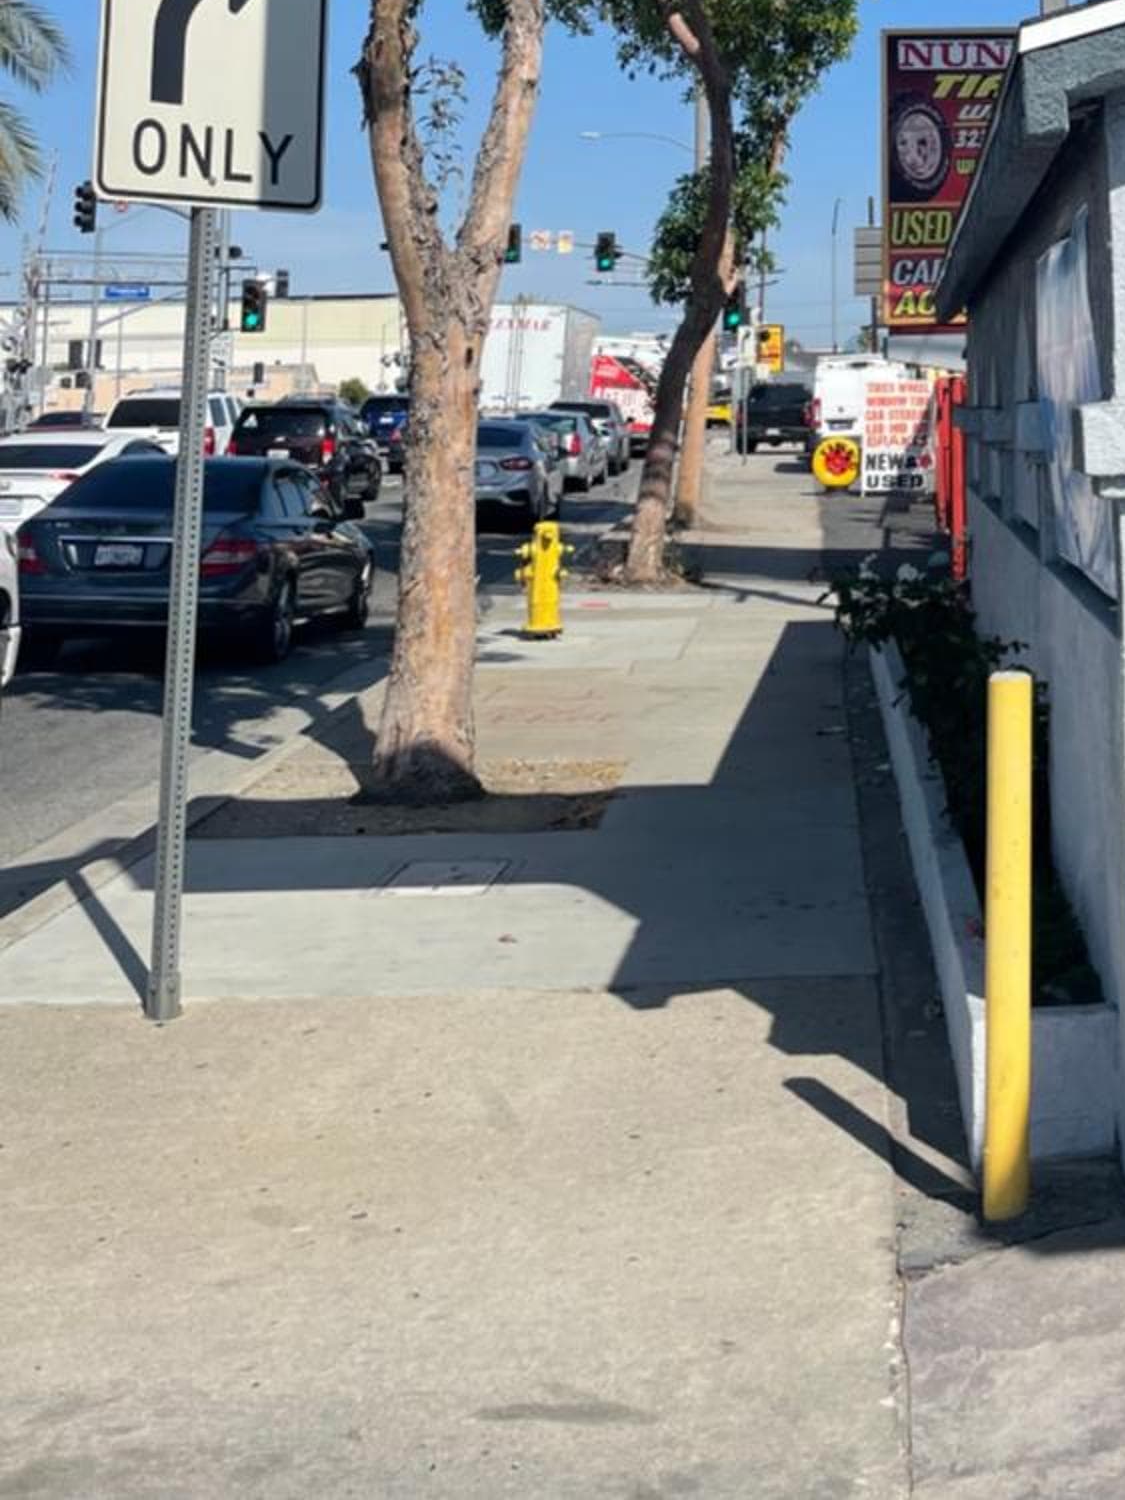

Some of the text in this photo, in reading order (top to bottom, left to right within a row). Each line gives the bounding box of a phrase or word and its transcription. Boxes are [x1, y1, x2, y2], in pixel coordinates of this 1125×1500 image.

[900, 40, 1010, 68] NUN
[954, 128, 986, 148] 32
[132, 117, 294, 186] ONLY
[891, 210, 953, 244] USED
[865, 453, 904, 471] NEW
[866, 474, 924, 489] USED
